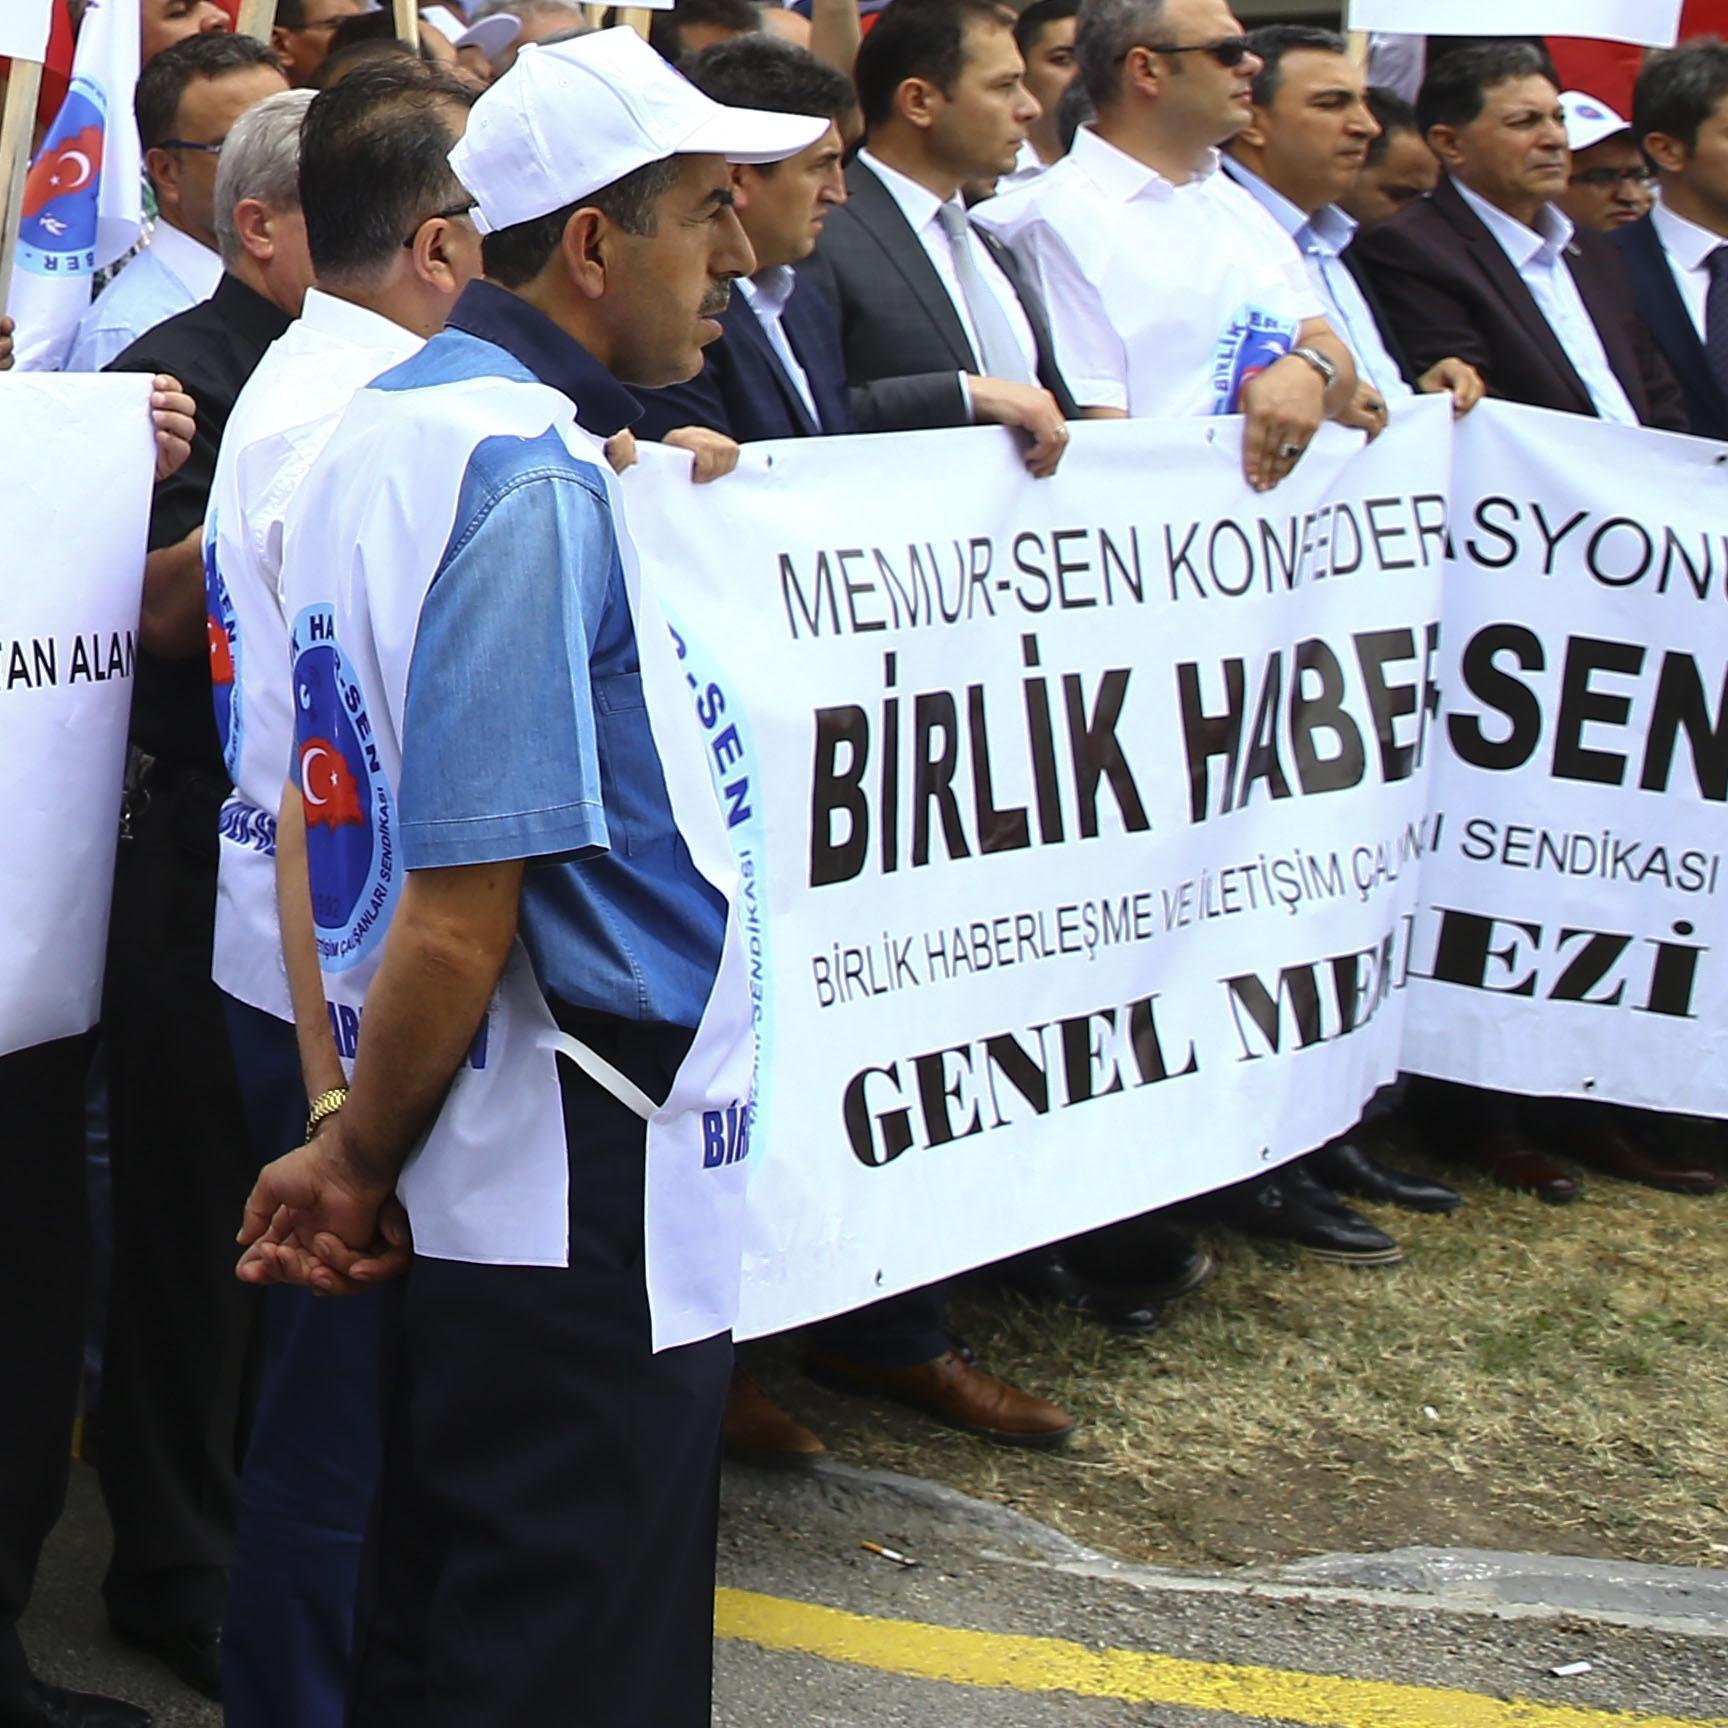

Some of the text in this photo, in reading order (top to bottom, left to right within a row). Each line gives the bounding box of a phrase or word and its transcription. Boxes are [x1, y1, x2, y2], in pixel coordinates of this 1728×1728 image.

[68, 629, 136, 686] ALAN
[779, 527, 1144, 640] MEMUR-SEN
[809, 633, 1152, 888] BİRLİK
[812, 930, 921, 1008] BİRLİK
[923, 892, 1152, 981] HABERLEŞME
[1161, 881, 1193, 931] VE
[1198, 848, 1345, 920] İLETİŞİM
[1460, 817, 1720, 894] SENDİKASI
[842, 994, 1199, 1168] GENEL
